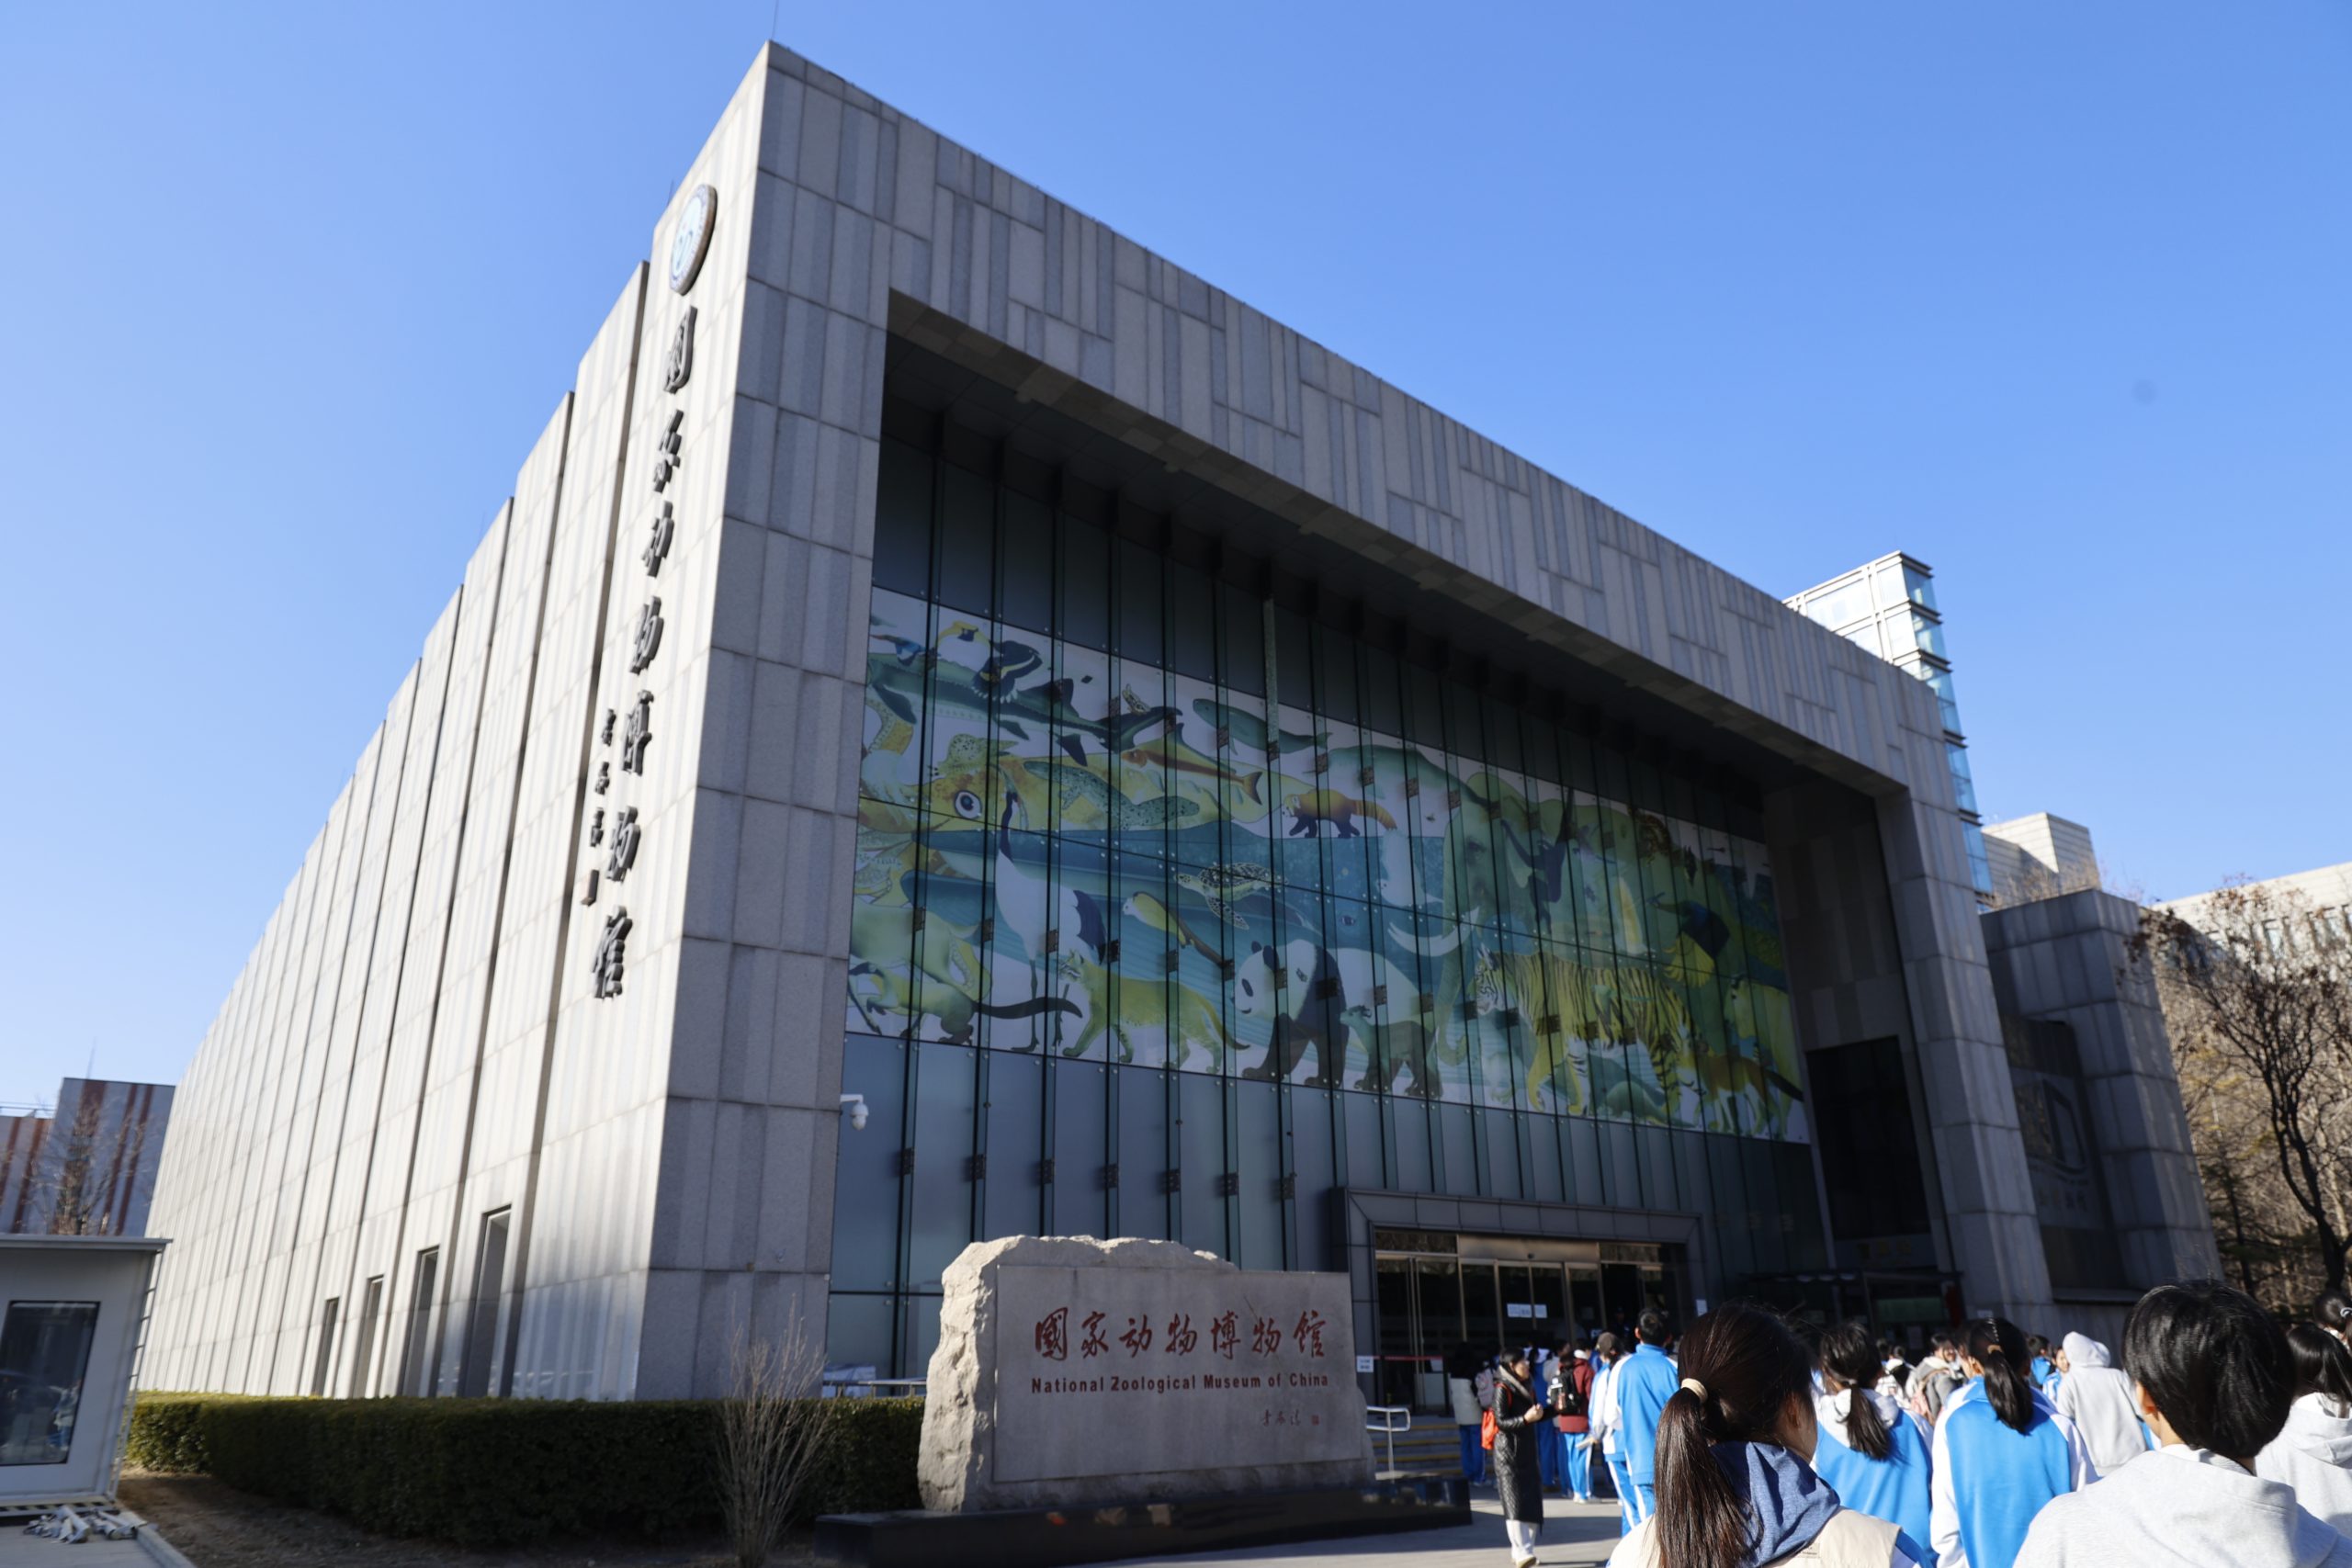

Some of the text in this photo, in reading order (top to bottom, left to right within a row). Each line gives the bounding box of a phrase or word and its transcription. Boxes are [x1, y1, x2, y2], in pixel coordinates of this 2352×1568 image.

[1032, 1372, 1329, 1393] National Zoological Museum of China
